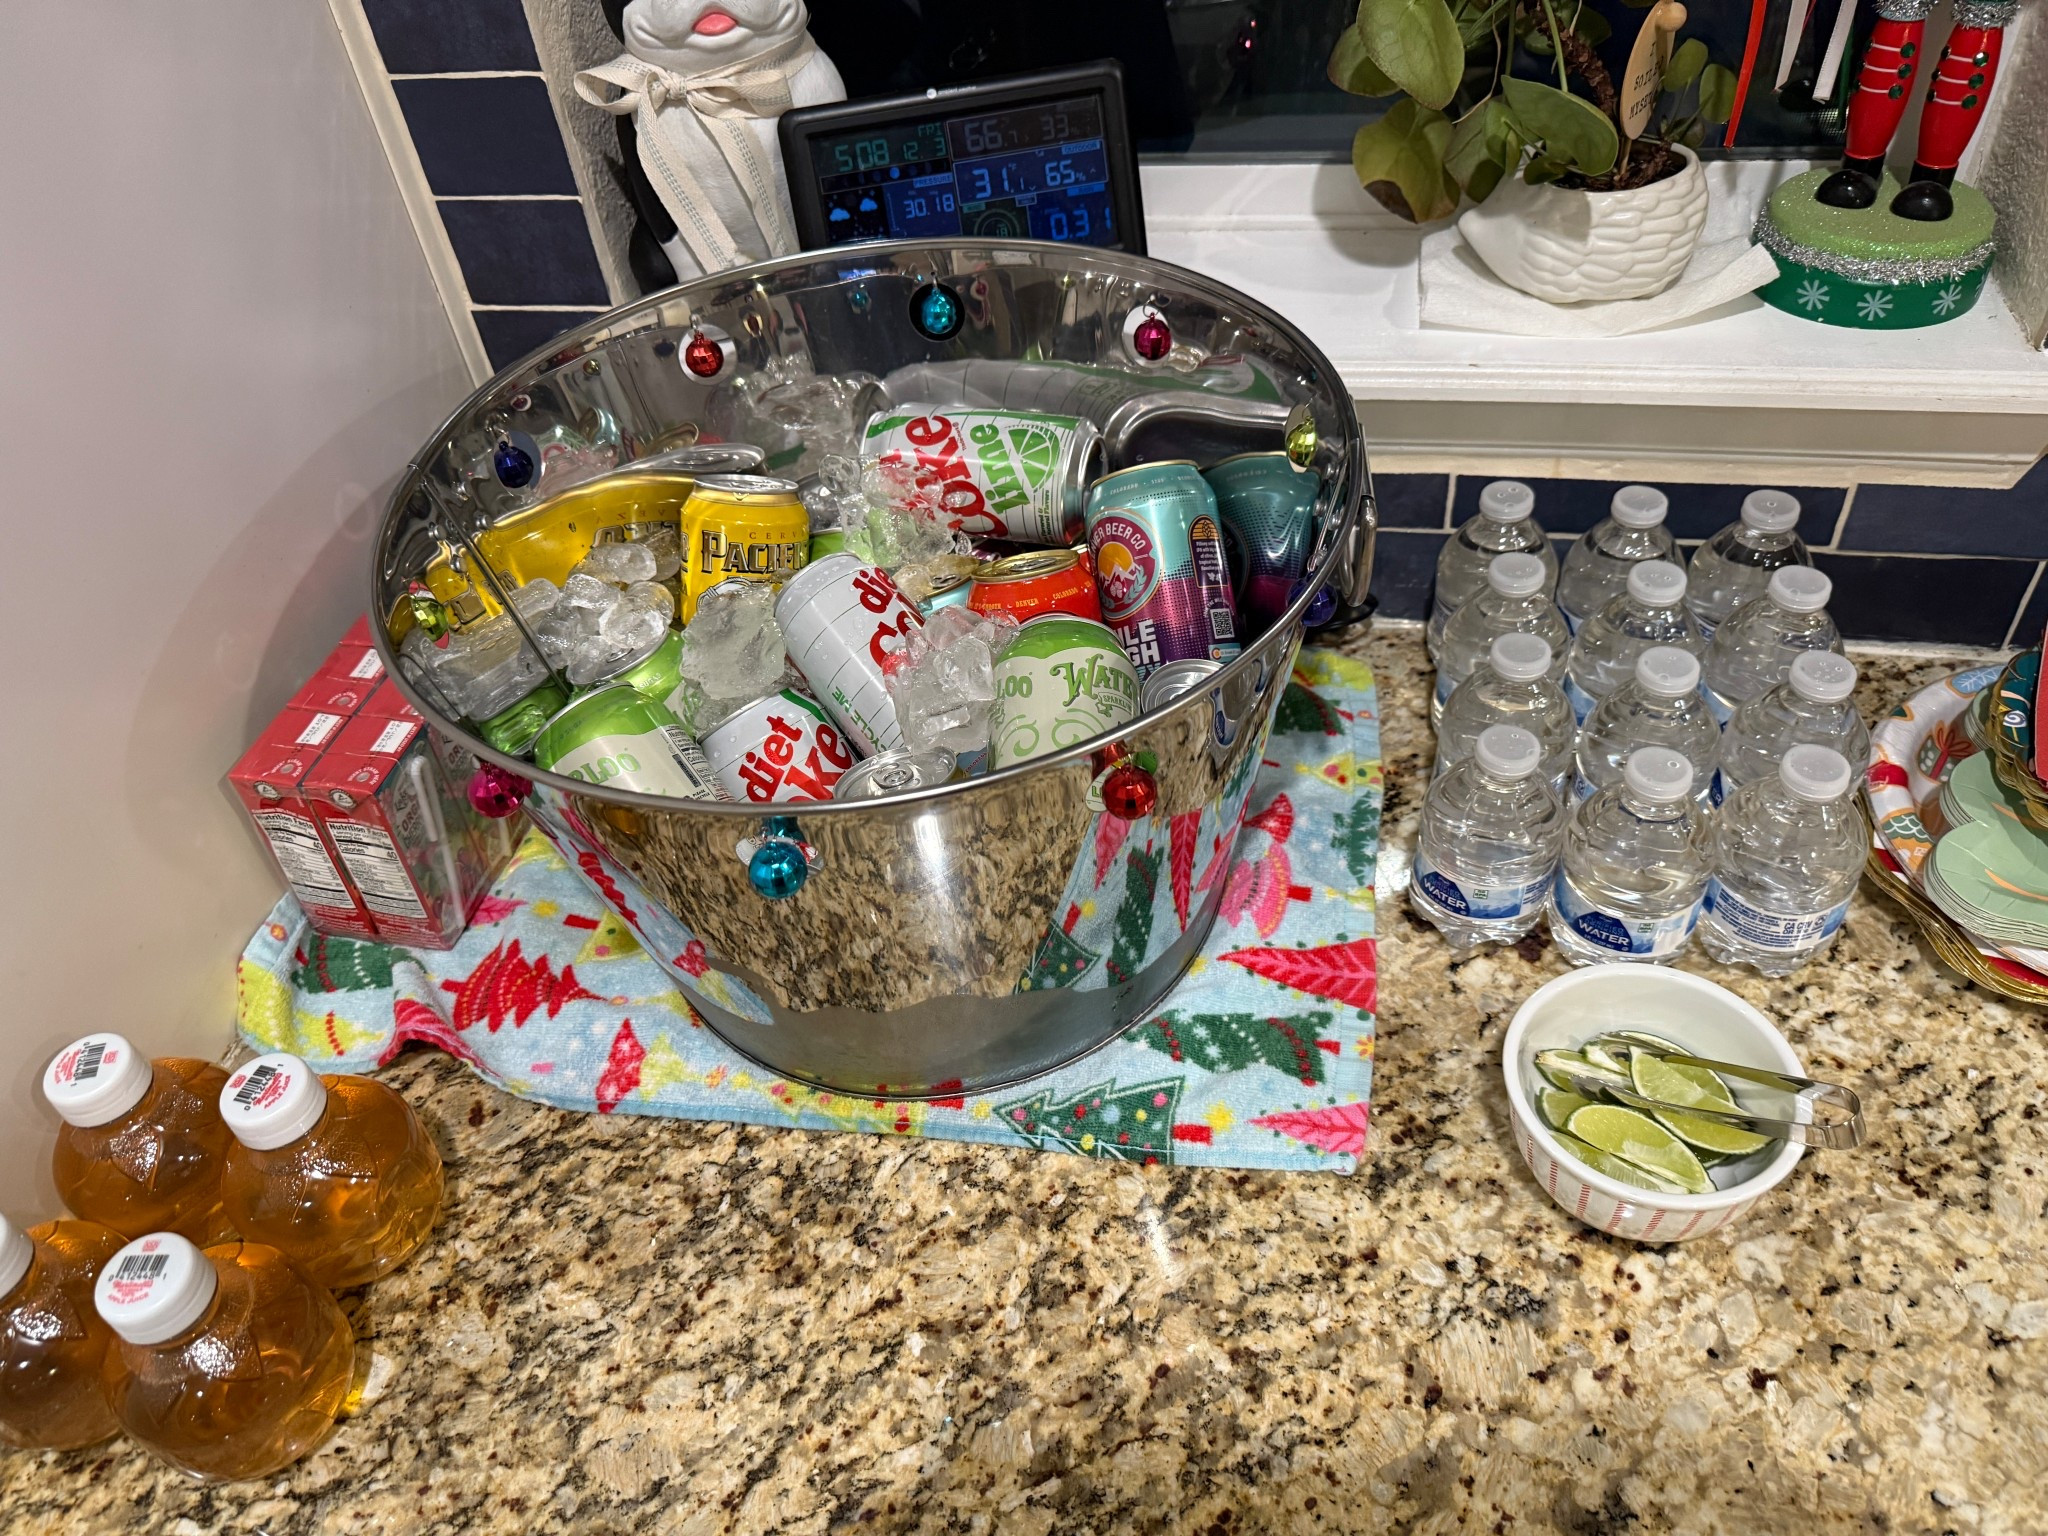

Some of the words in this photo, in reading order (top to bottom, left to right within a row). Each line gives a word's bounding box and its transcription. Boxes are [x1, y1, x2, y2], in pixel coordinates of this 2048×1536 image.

[917, 122, 943, 138] FRI
[969, 423, 1031, 515] lime
[749, 532, 804, 540] CERV
[1105, 522, 1133, 539] BEER
[852, 567, 898, 614] die
[1015, 598, 1040, 608] DENVER
[1127, 640, 1161, 667] GH
[831, 685, 854, 714] ME
[850, 714, 887, 753] CYCLE
[738, 715, 804, 803] diet
[329, 823, 366, 834] Nutrition
[386, 851, 398, 860] 40
[1423, 877, 1467, 911] WATER
[1578, 918, 1630, 946] WATER
[1783, 922, 1796, 930] CA
